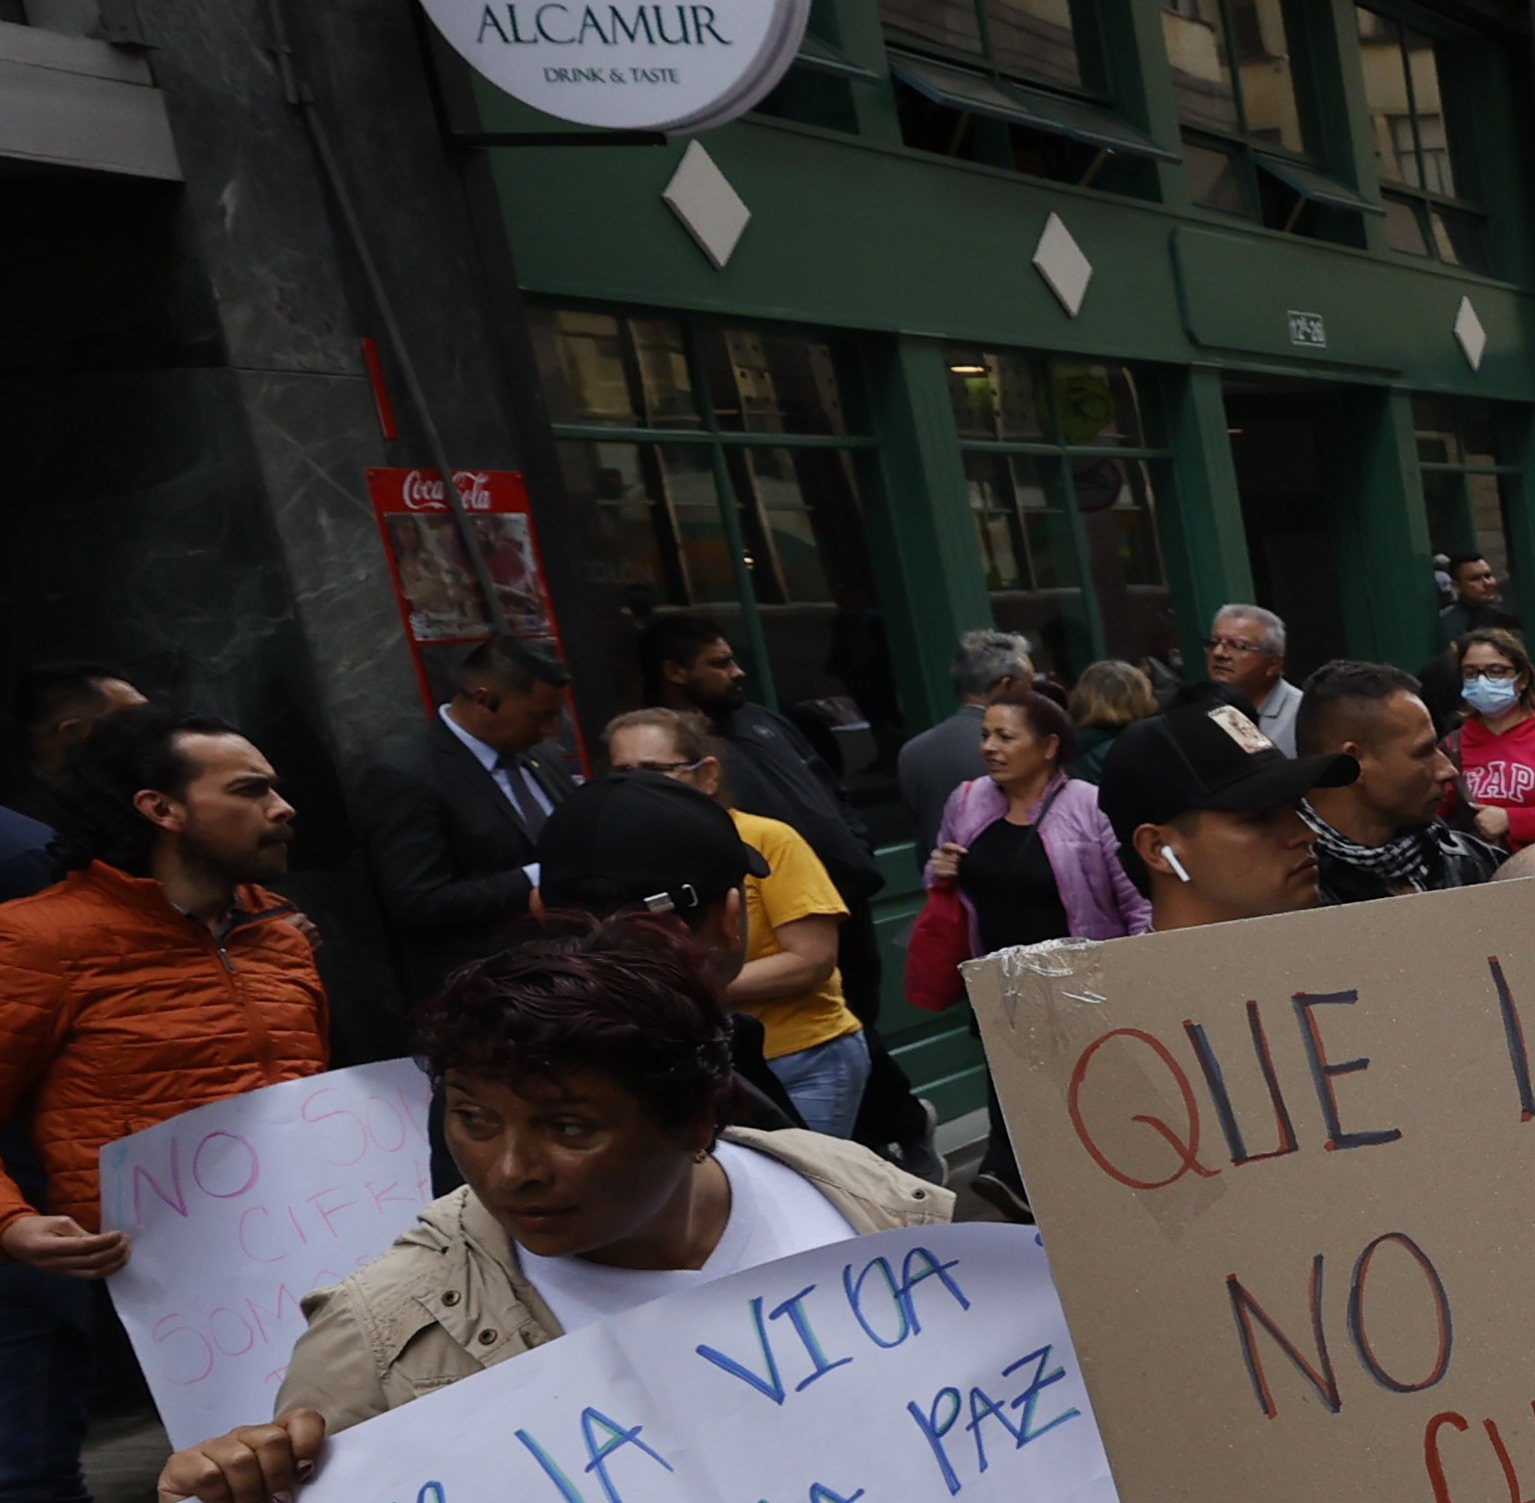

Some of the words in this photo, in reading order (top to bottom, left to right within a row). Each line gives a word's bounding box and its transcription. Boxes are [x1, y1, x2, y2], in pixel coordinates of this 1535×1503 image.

[476, 3, 733, 46] ALCAMUR
[544, 66, 606, 84] DRINK
[608, 68, 627, 84] &
[629, 67, 681, 85] TASTE
[1067, 988, 1402, 1191] QUE
[132, 1129, 260, 1226] NO
[695, 1245, 973, 1405] VIDA
[1226, 1230, 1454, 1420] NO
[906, 1343, 1082, 1497] PAZ
